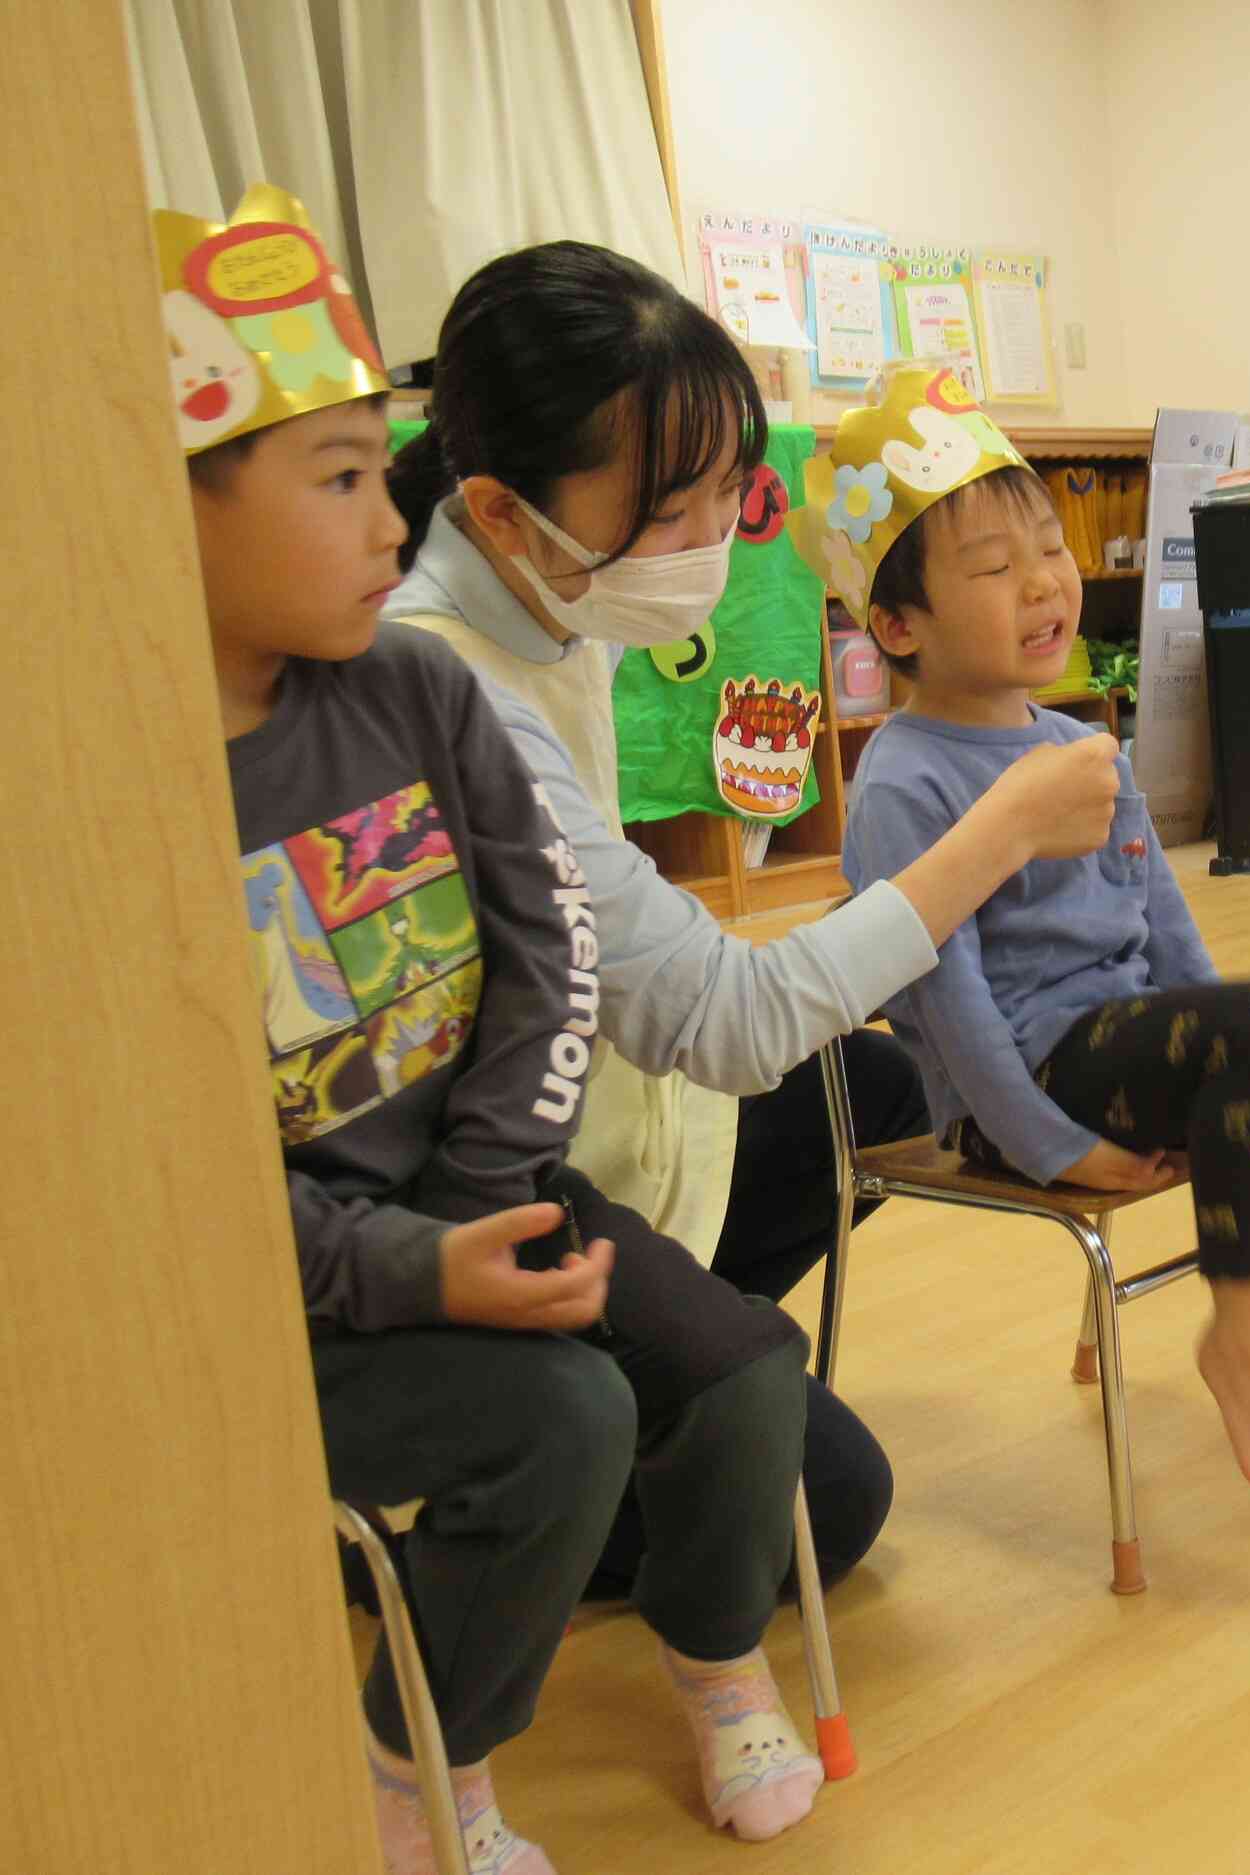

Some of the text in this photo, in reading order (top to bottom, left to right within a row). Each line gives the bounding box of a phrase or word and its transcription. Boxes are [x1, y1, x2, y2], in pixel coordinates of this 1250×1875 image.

[703, 214, 791, 239] えんだより
[809, 231, 889, 257] ほけんだより
[910, 262, 951, 280] だより
